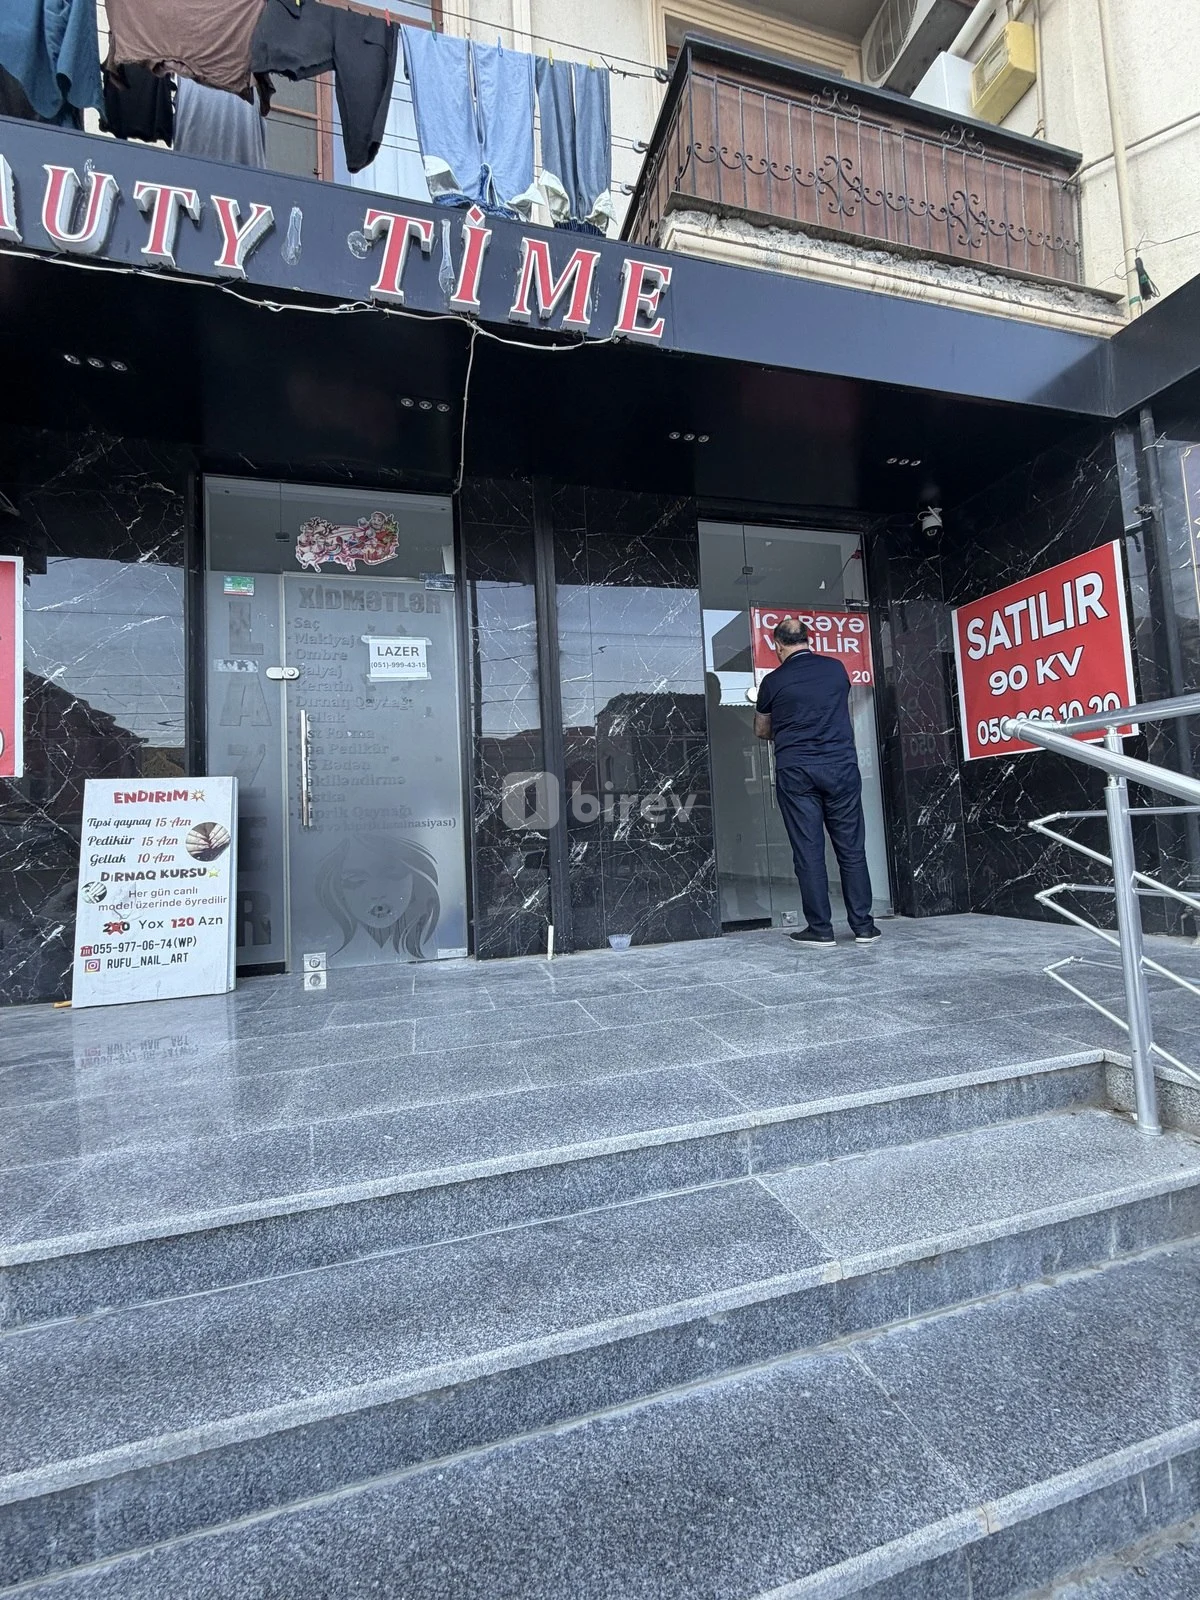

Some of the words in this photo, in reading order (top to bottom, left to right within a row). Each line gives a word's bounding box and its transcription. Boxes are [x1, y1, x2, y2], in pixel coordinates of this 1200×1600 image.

[755, 609, 865, 633] İCRƏYƏ
[966, 571, 1109, 661] SATILIR
[294, 617, 320, 632] Saç
[295, 633, 355, 648] Makiyaj
[296, 649, 348, 661] Ombre
[377, 646, 420, 657] LAZER
[852, 670, 871, 683] 20
[988, 664, 1028, 697] 90
[1036, 645, 1085, 685] KV
[114, 789, 188, 804] ENDIRIM
[87, 817, 111, 829] Tipsi
[113, 818, 152, 829] qaynaq
[155, 817, 167, 827] 15
[170, 817, 191, 828] Azn
[87, 835, 135, 846] Pedikür
[141, 836, 154, 846] 15
[156, 835, 178, 846] Azn
[90, 853, 126, 867] Gellak
[137, 853, 150, 863] 10
[152, 853, 175, 863] Azn
[160, 867, 207, 879] KURSU
[128, 889, 148, 898] Her
[150, 888, 171, 899] gün
[173, 886, 198, 896] canlı
[98, 901, 133, 911] model
[135, 899, 182, 909] üzerinde
[184, 896, 228, 907] öyredilir
[138, 919, 164, 930] Yox
[171, 916, 195, 928] 120
[198, 916, 223, 926] Azn
[107, 952, 189, 969] RUFU_NAIL_ART
